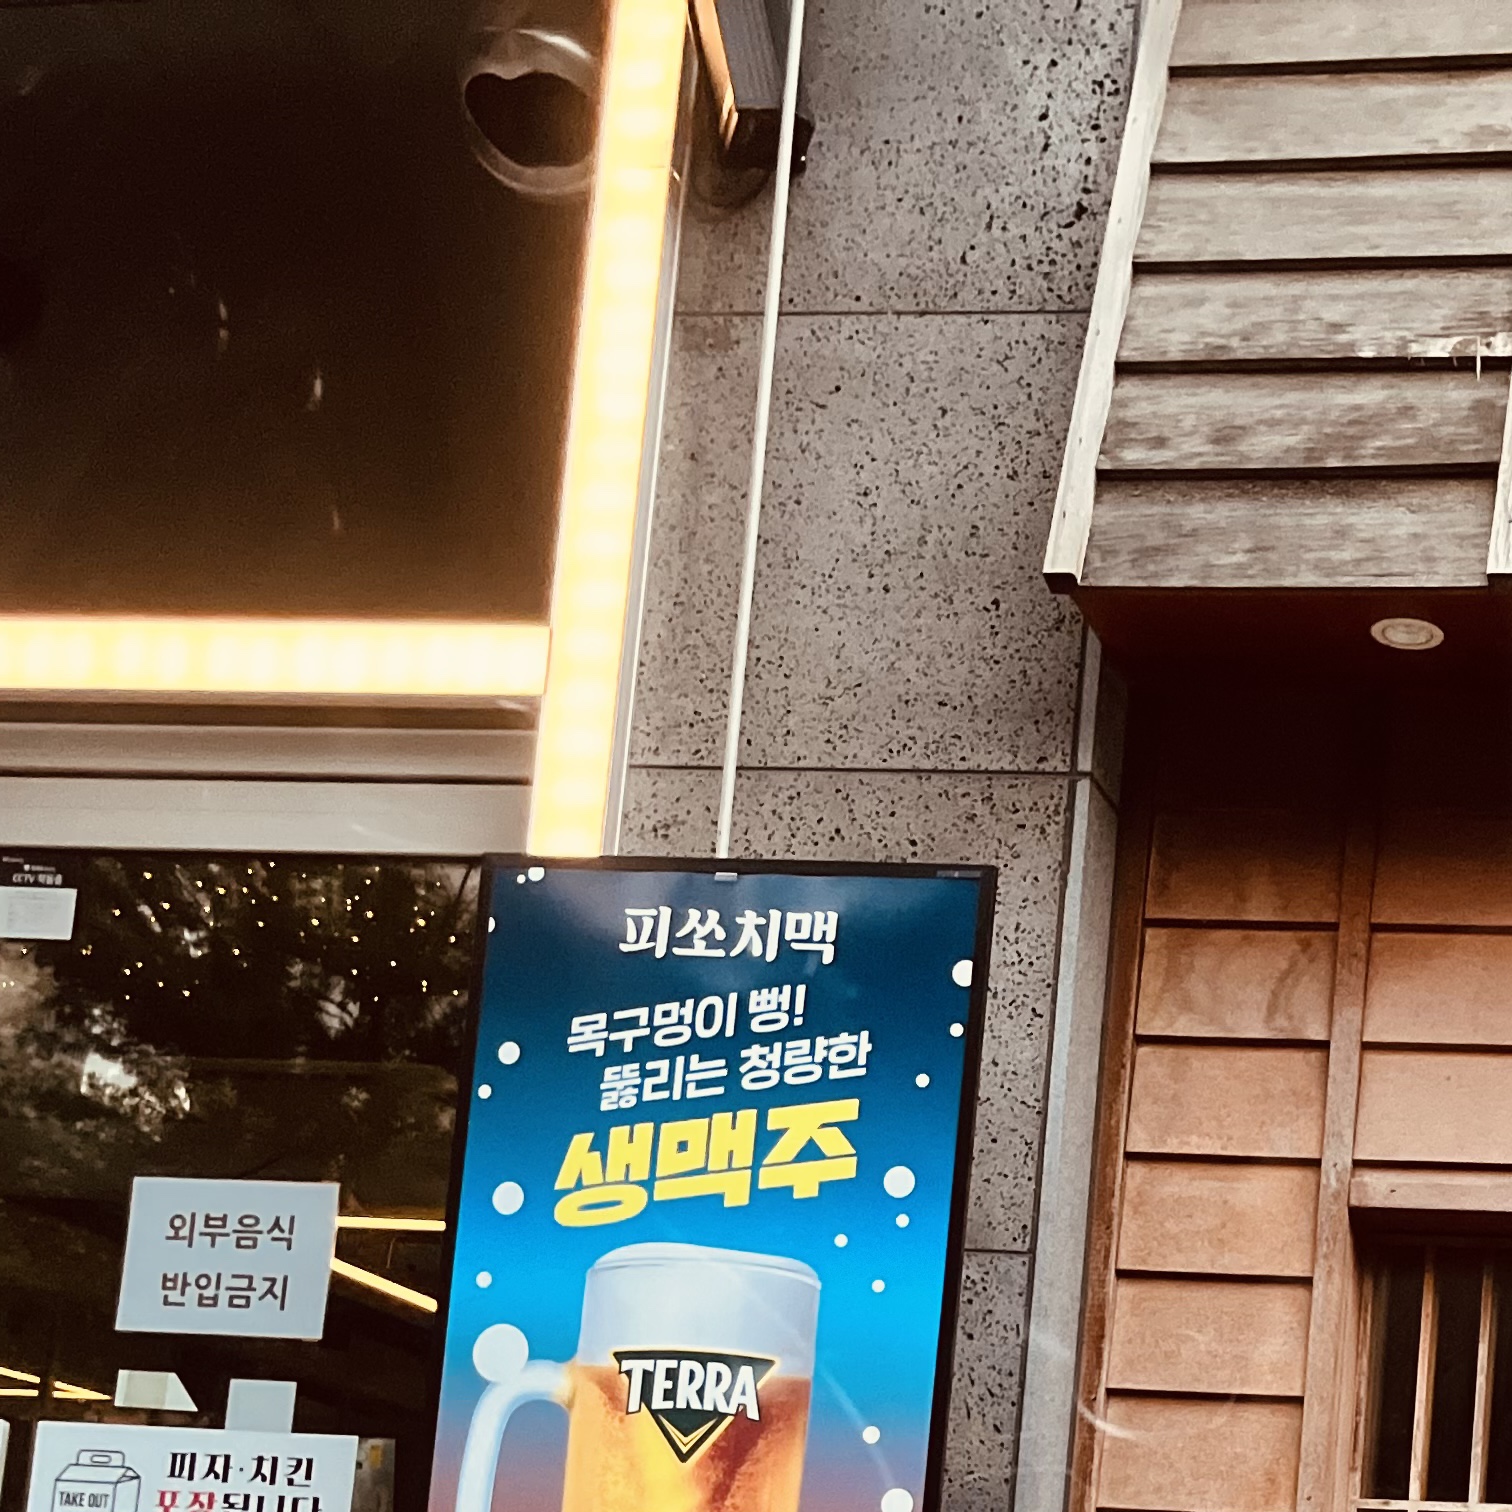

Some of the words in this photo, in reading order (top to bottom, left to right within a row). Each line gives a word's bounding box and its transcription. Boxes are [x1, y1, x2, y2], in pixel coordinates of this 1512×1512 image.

[618, 905, 839, 965] 피쏘치맥
[566, 992, 738, 1056] 목구멍이
[748, 984, 807, 1034] 뻥!
[599, 1054, 728, 1112] 뚫리는
[739, 1031, 872, 1091] 청량한
[553, 1098, 860, 1228] 생맥주
[165, 1212, 296, 1251] 외부음식
[161, 1272, 289, 1312] 반입금지
[619, 1359, 762, 1421] TERRA
[59, 1491, 85, 1508] TAKE
[88, 1493, 110, 1509] OUT
